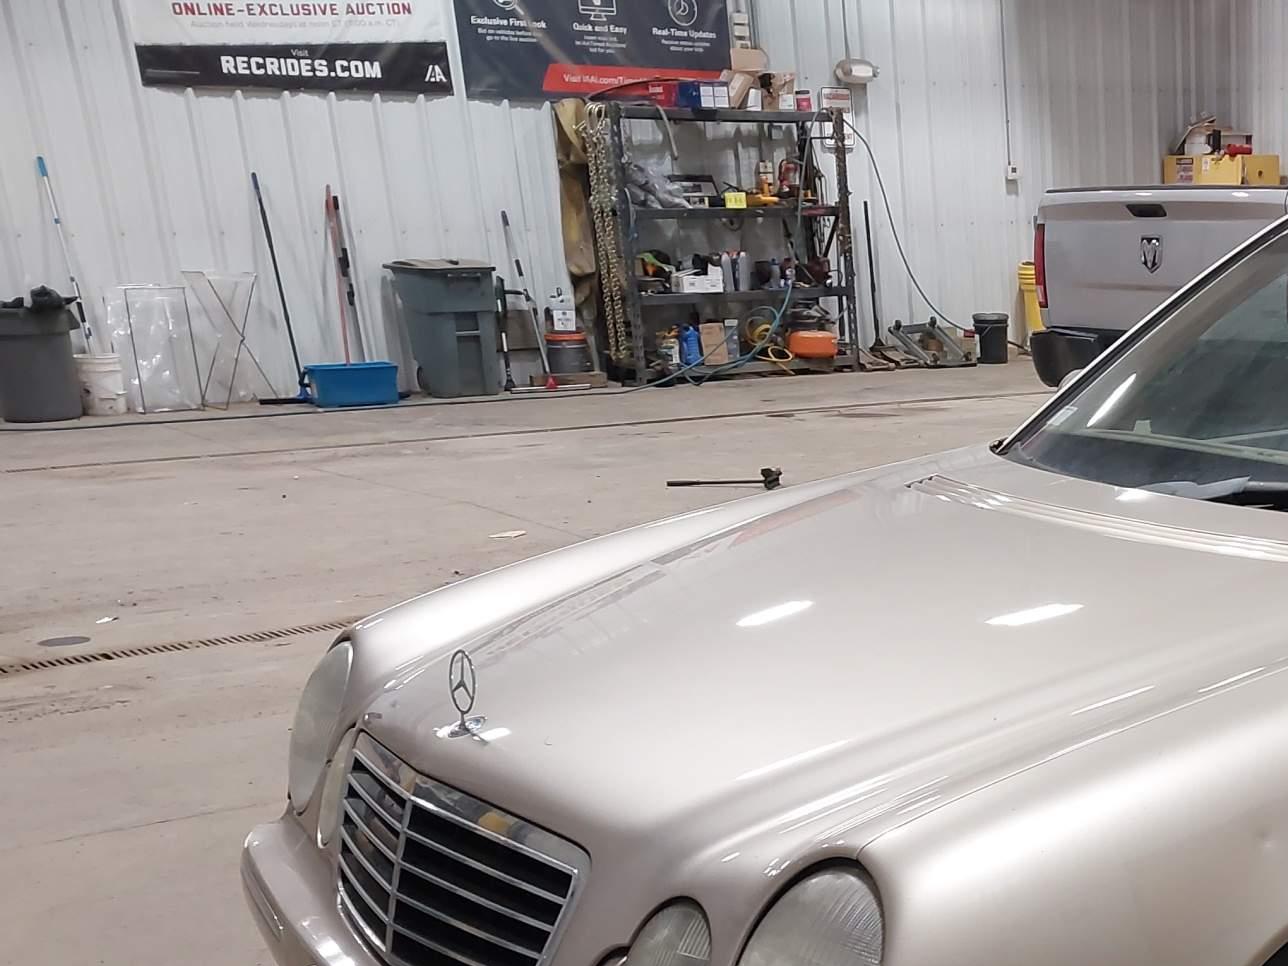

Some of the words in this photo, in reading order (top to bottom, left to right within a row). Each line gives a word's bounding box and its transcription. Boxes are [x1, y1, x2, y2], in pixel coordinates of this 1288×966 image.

[172, 2, 339, 16] ONLINE-EXCLUSIVE
[345, 2, 412, 15] AUCTION
[470, 15, 508, 26] Exclusive
[572, 22, 593, 31] Quick
[609, 25, 627, 35] Easy
[652, 27, 688, 36] Real-Time
[688, 30, 717, 39] Updates
[290, 49, 308, 57] Visit
[220, 55, 382, 79] RECRIDES.COM
